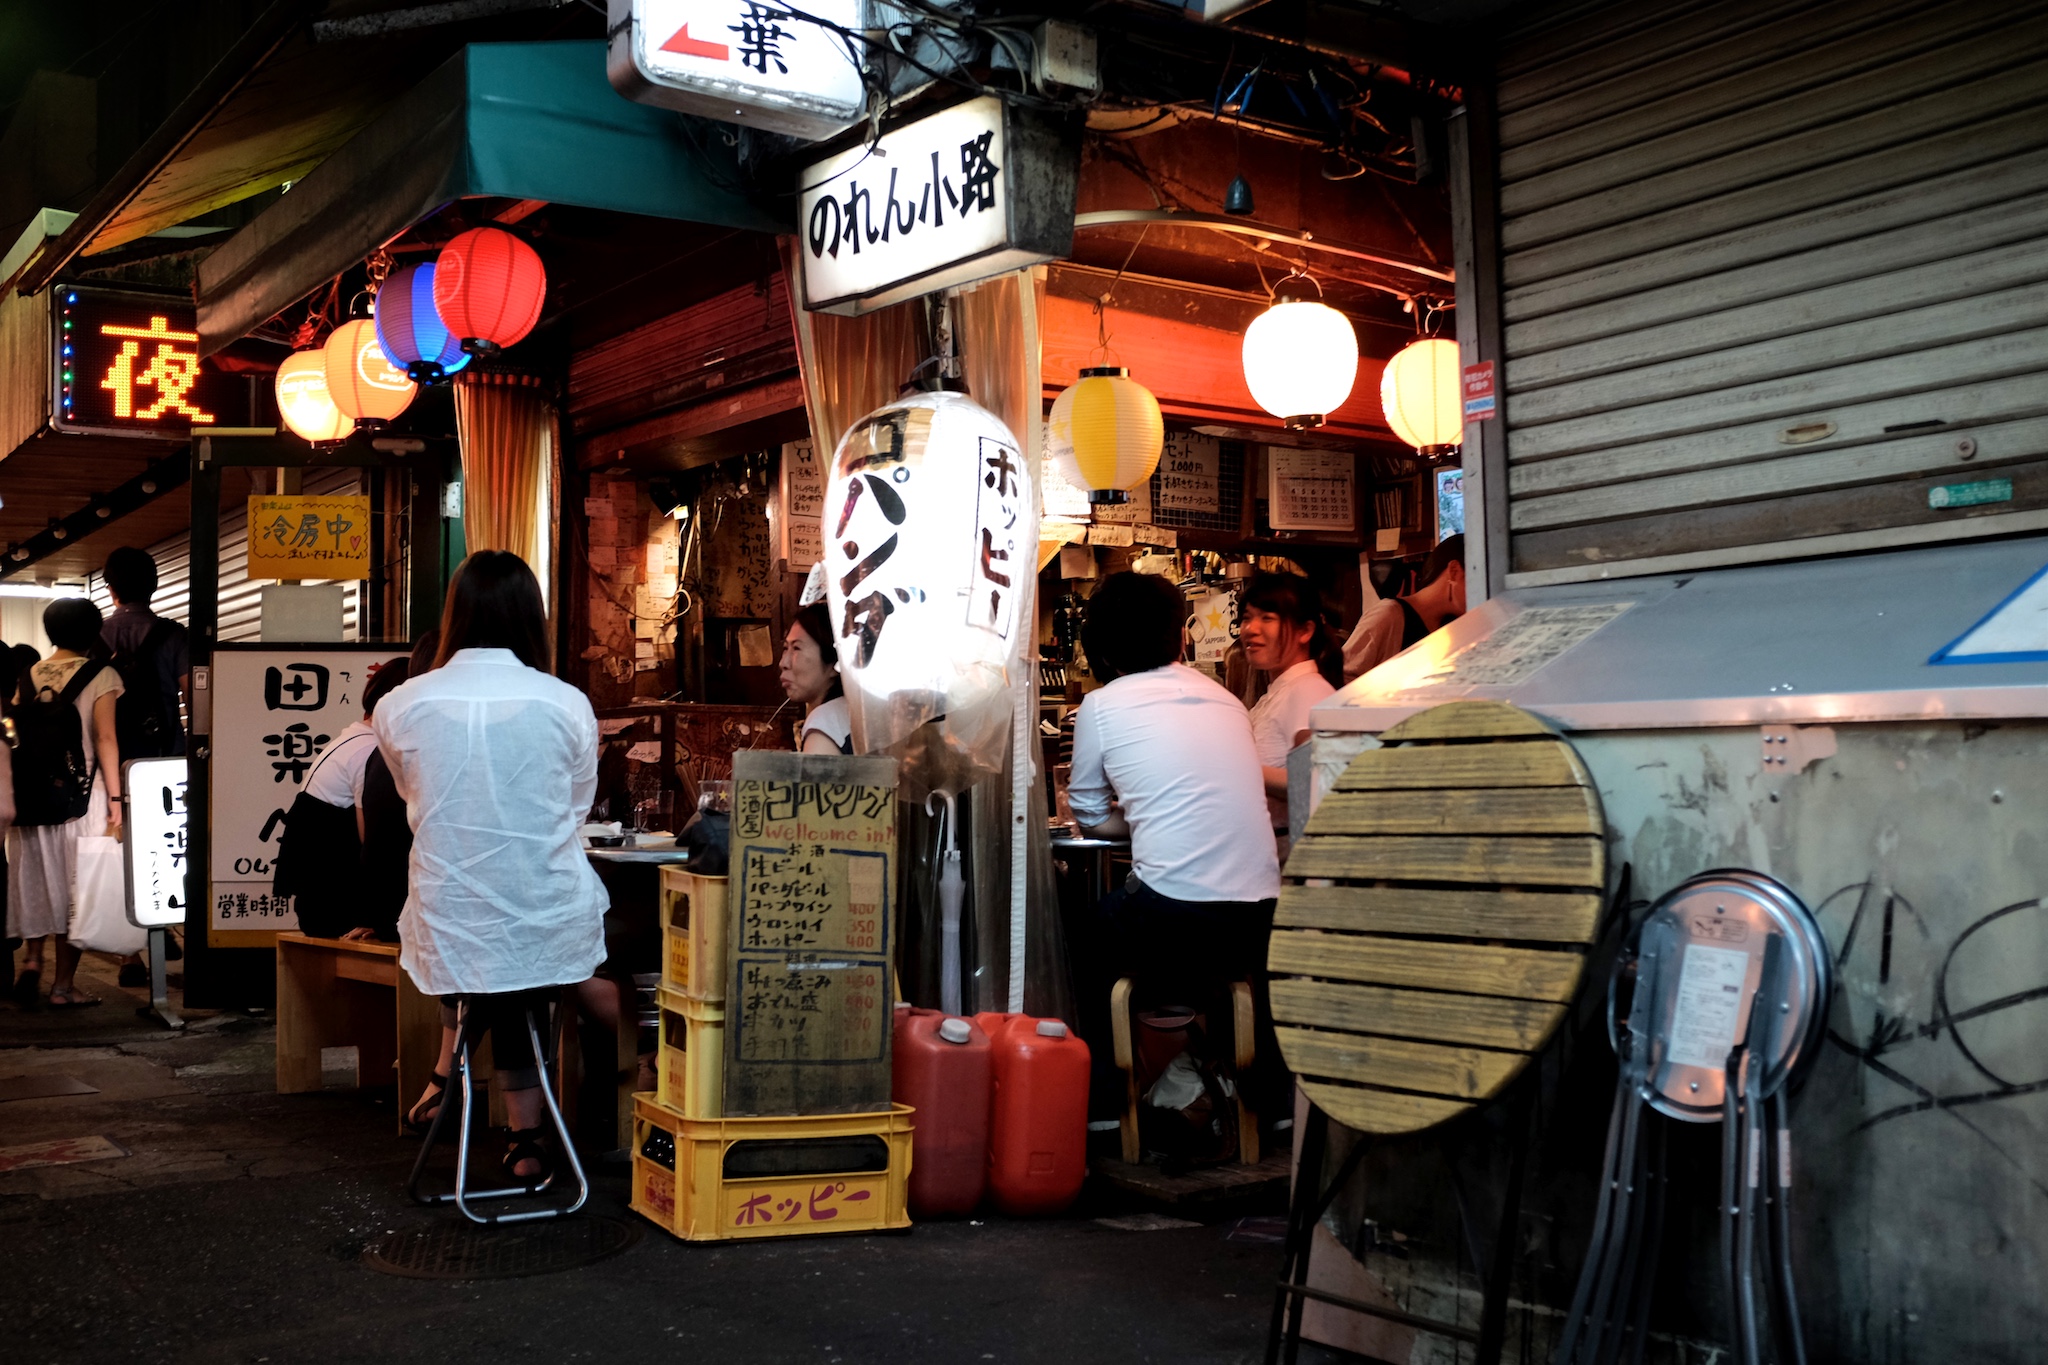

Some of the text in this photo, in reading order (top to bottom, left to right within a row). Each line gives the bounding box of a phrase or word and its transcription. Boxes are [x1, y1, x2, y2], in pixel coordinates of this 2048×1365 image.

[809, 130, 1000, 260] のれん小路
[100, 316, 215, 423] 夜
[1164, 442, 1193, 459] セット
[1169, 459, 1214, 473] 1000円
[263, 513, 353, 550] 冷房中
[835, 407, 927, 668] コパンダ
[979, 448, 1018, 625] ホッピー
[1204, 635, 1227, 645] SAPPORO
[258, 662, 331, 843] 田楽
[751, 854, 816, 878] 生ビール
[217, 893, 290, 919] 営業時間
[735, 1181, 871, 1226] ホッピー
